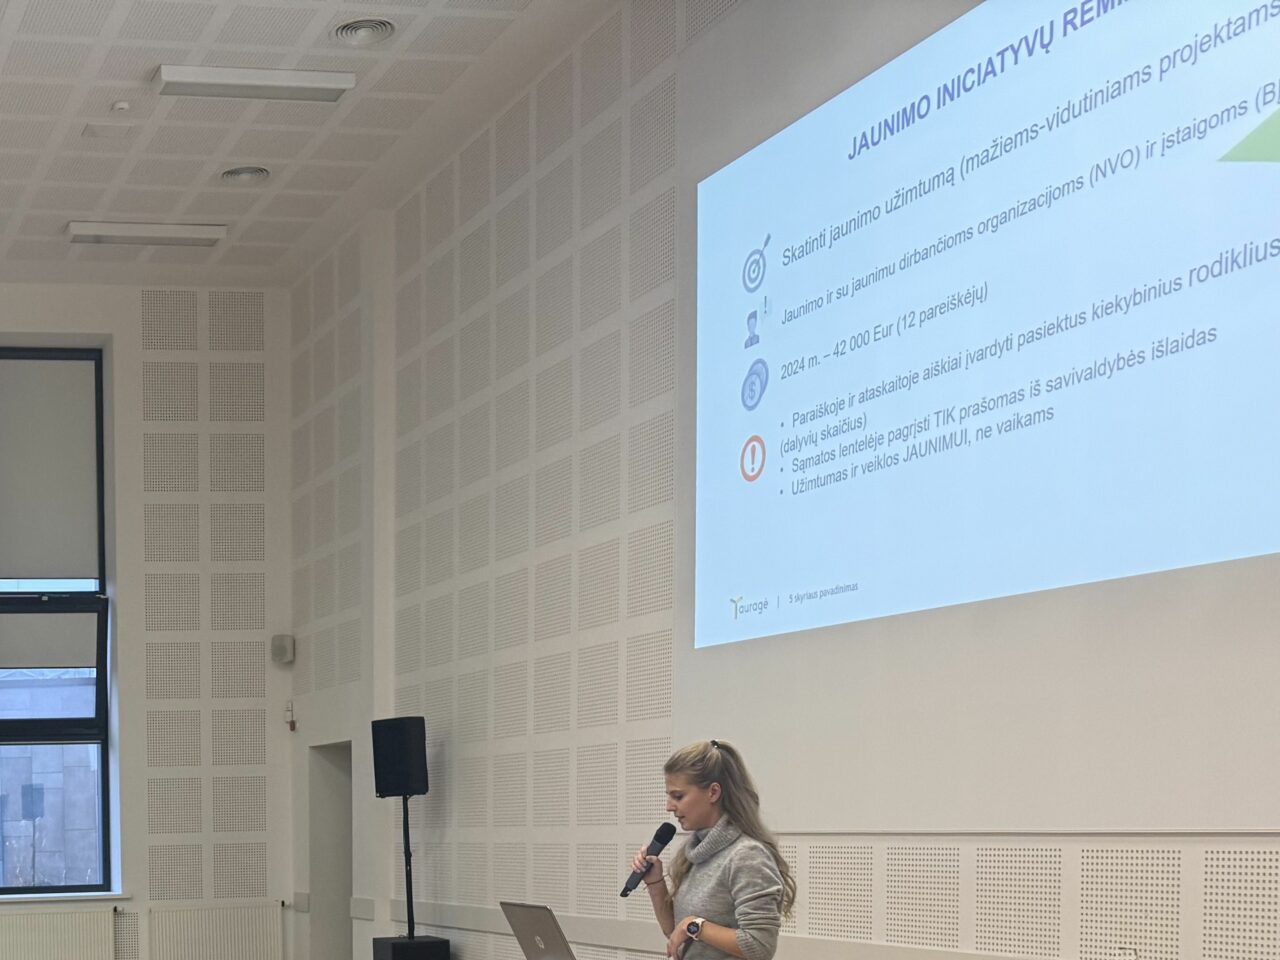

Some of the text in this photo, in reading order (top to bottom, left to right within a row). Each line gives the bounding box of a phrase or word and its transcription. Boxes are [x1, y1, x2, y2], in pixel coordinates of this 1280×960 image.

[782, 0, 1280, 266] Skatinti jaunimo užimtumą (mažiems-vidutiniams projektams
[847, 94, 930, 160] JAUNIMO
[936, 19, 1054, 110] INICIATYVŲ
[781, 296, 824, 325] Jaunimo
[826, 289, 834, 304] ir
[836, 284, 849, 300] su
[851, 261, 895, 297] jaunimu
[899, 225, 974, 271] dirbančioms
[977, 175, 1084, 235] organizacijoms
[1089, 145, 1140, 188] (NVO)
[1146, 139, 1157, 159] ir
[1160, 99, 1248, 157] įstaigoms
[780, 361, 806, 380] 2024
[808, 354, 821, 370] m.
[832, 339, 847, 359] 42
[849, 329, 870, 352] 000
[873, 322, 894, 343] Eur
[896, 310, 916, 337] (12
[919, 281, 988, 329] pareiškėjų)
[792, 238, 1280, 428] Paraiškoje ir ataskaitoje aiškiai įvardyti pasiektus kiekybinius rodiklius
[792, 326, 1217, 474] Sąmatos lentelėje pagrįsti TIK prašomas iš savivaldybės išlaidas
[780, 412, 867, 458] (dalyvių skaičius)
[791, 406, 1055, 495] Užimtumas ir veiklos JAUNIMUI, ne vaikams
